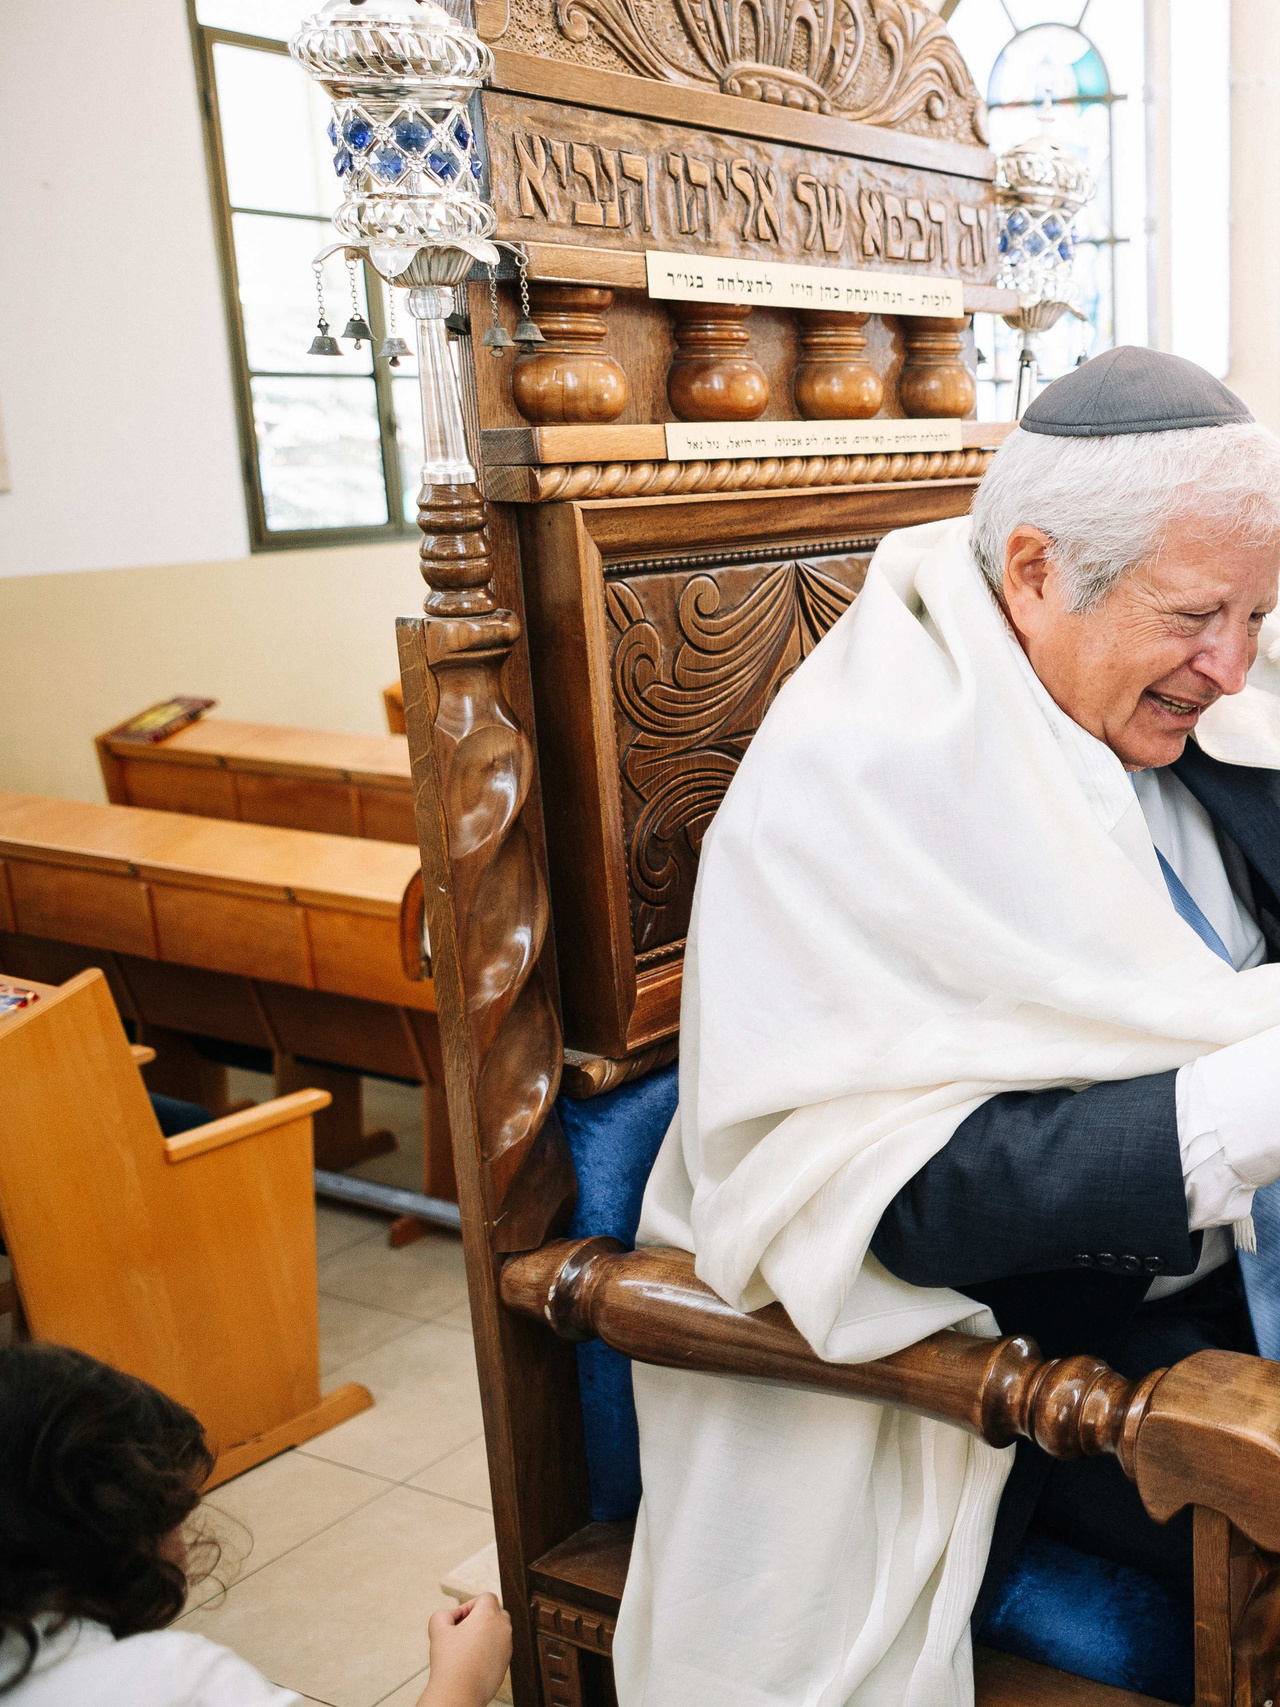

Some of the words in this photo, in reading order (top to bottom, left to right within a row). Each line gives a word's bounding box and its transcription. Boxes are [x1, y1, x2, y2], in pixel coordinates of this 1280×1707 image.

[513, 131, 653, 233] הנביא
[667, 151, 782, 243] אליהו
[795, 170, 847, 254] של
[858, 187, 950, 263] הכסא
[717, 271, 773, 294] להצלחה
[820, 285, 841, 302] כהן
[846, 288, 879, 305] ויצחק
